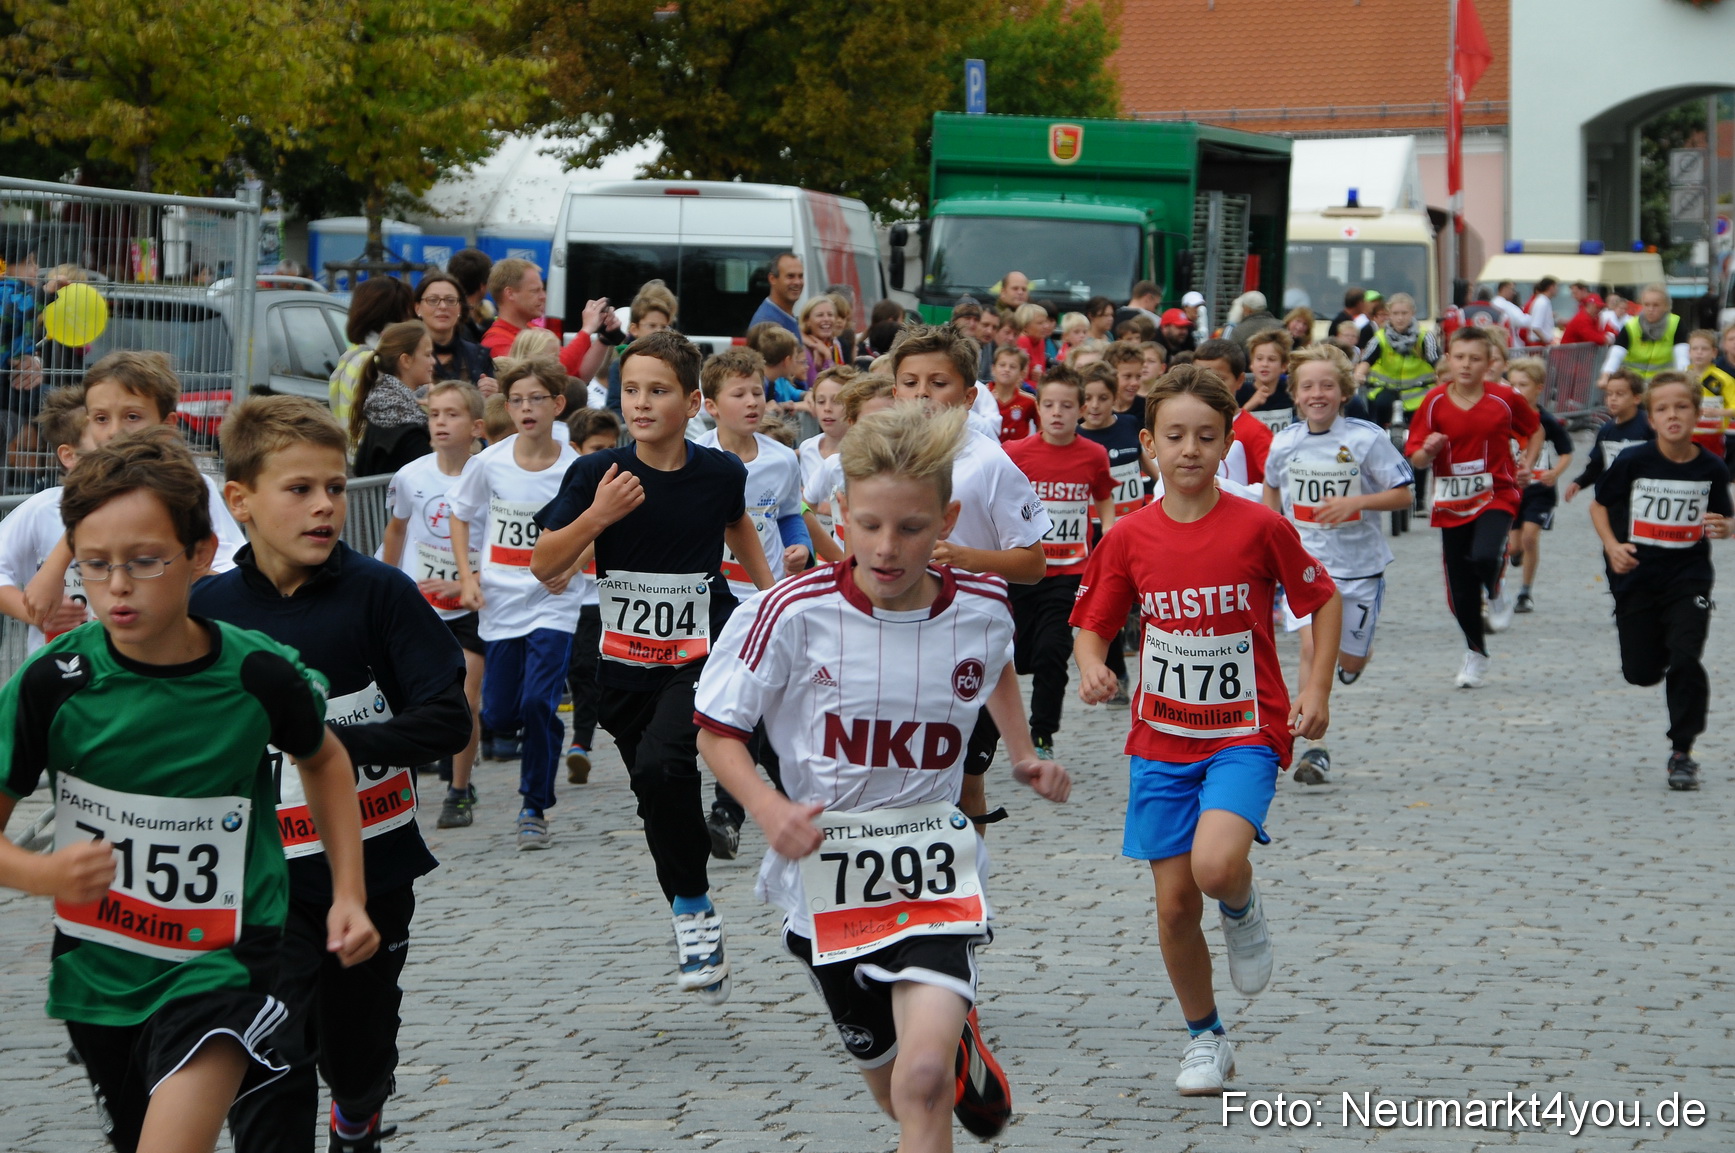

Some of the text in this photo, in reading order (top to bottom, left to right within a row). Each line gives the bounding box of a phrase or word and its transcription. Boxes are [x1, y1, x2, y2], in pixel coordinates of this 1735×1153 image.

[970, 67, 982, 106] P
[1295, 479, 1351, 502] 7067
[1442, 476, 1485, 497] 7078
[1663, 487, 1699, 495] Neumarkt
[491, 505, 511, 515] PARTL
[1642, 495, 1700, 522] 7075
[497, 518, 540, 546] 739
[1042, 518, 1079, 541] 244
[1045, 547, 1070, 557] abian
[600, 579, 692, 594] PARTL Neumarkt
[611, 596, 696, 637] 7204
[1357, 603, 1369, 629] 7
[628, 641, 678, 660] Marcel
[1146, 634, 1232, 657] PARTL Neumarkt
[957, 675, 981, 690] FCN
[1152, 655, 1241, 701] 7178
[1153, 700, 1242, 726] Maximilian
[823, 711, 962, 770] NKD
[61, 788, 214, 832] PARTL Neumarkt
[823, 817, 943, 841] RTL Neumarkt
[820, 842, 956, 905] 7293
[223, 894, 234, 905] M
[97, 896, 183, 942] Maxim
